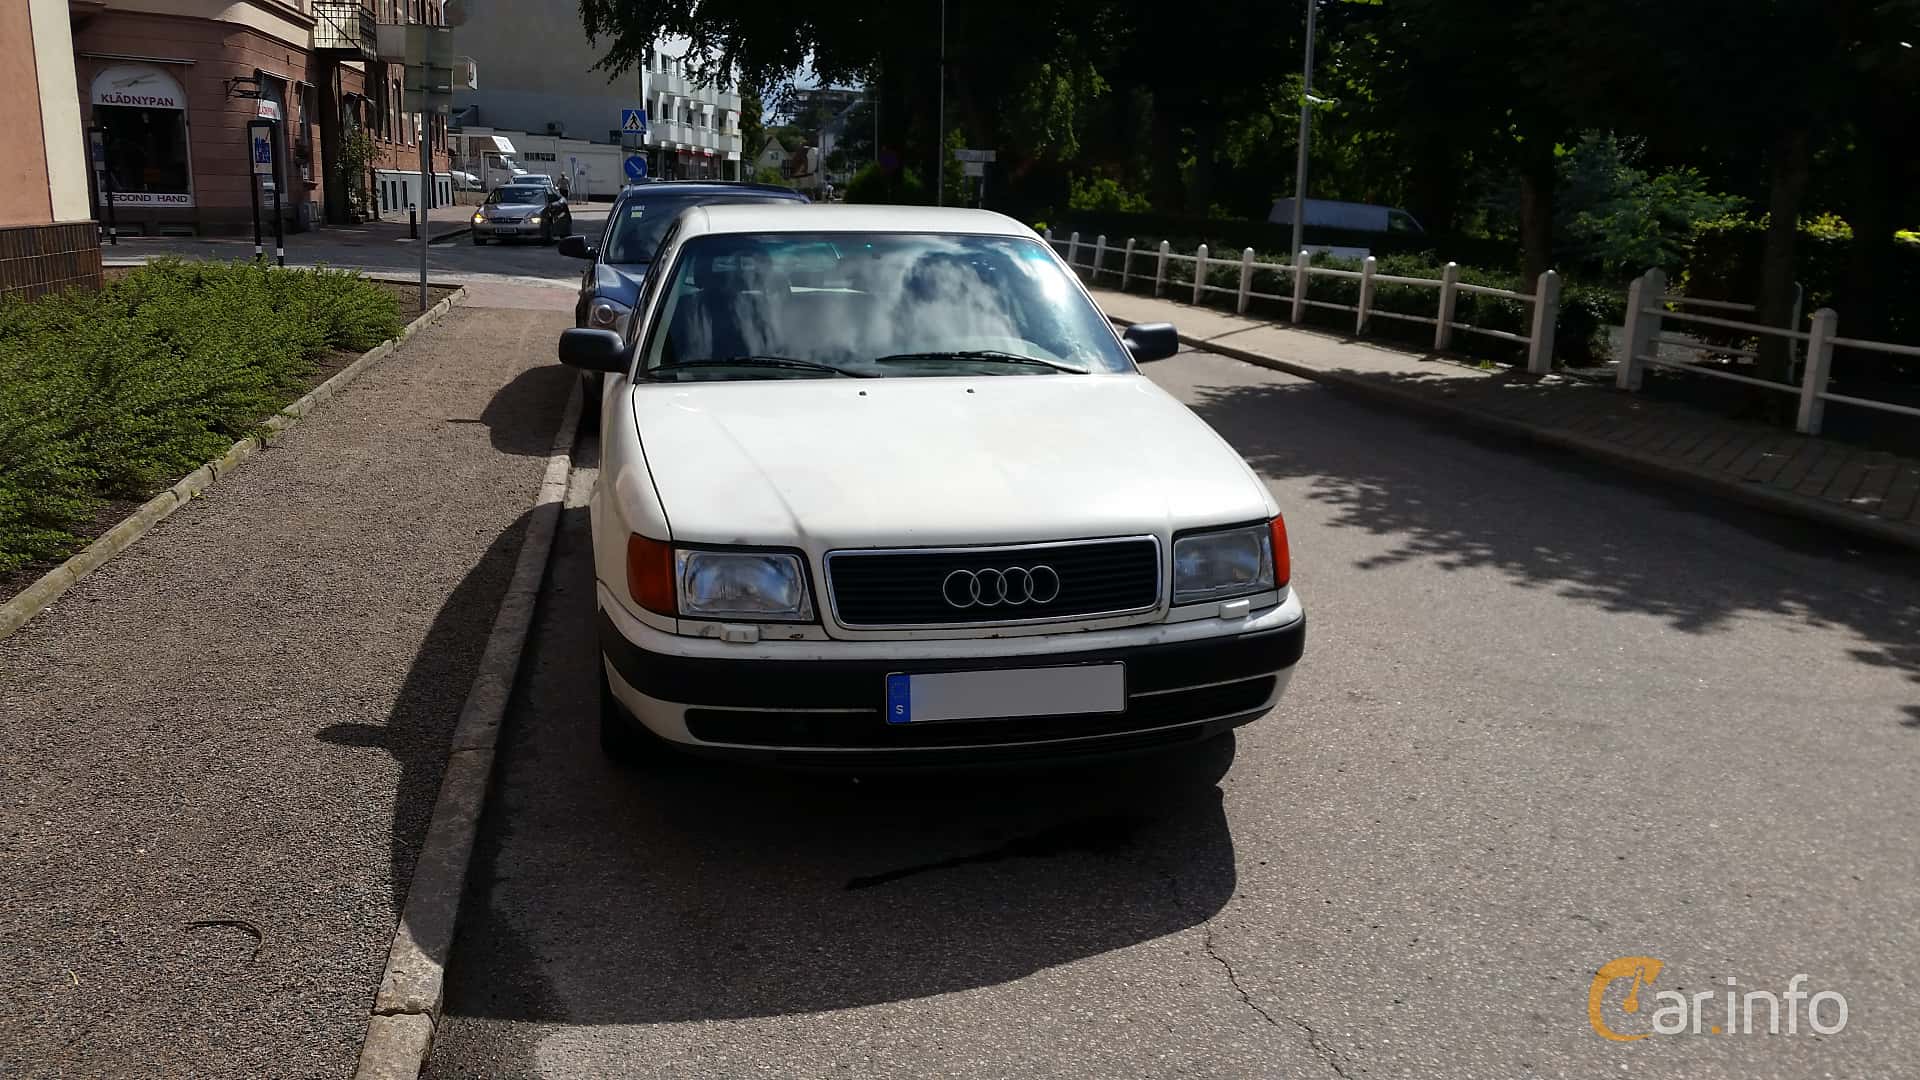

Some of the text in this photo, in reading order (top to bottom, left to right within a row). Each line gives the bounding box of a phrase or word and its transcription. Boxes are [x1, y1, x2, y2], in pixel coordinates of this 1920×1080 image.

[100, 91, 175, 107] KLÄDNYPAN
[157, 194, 188, 202] HAND
[895, 704, 904, 715] S
